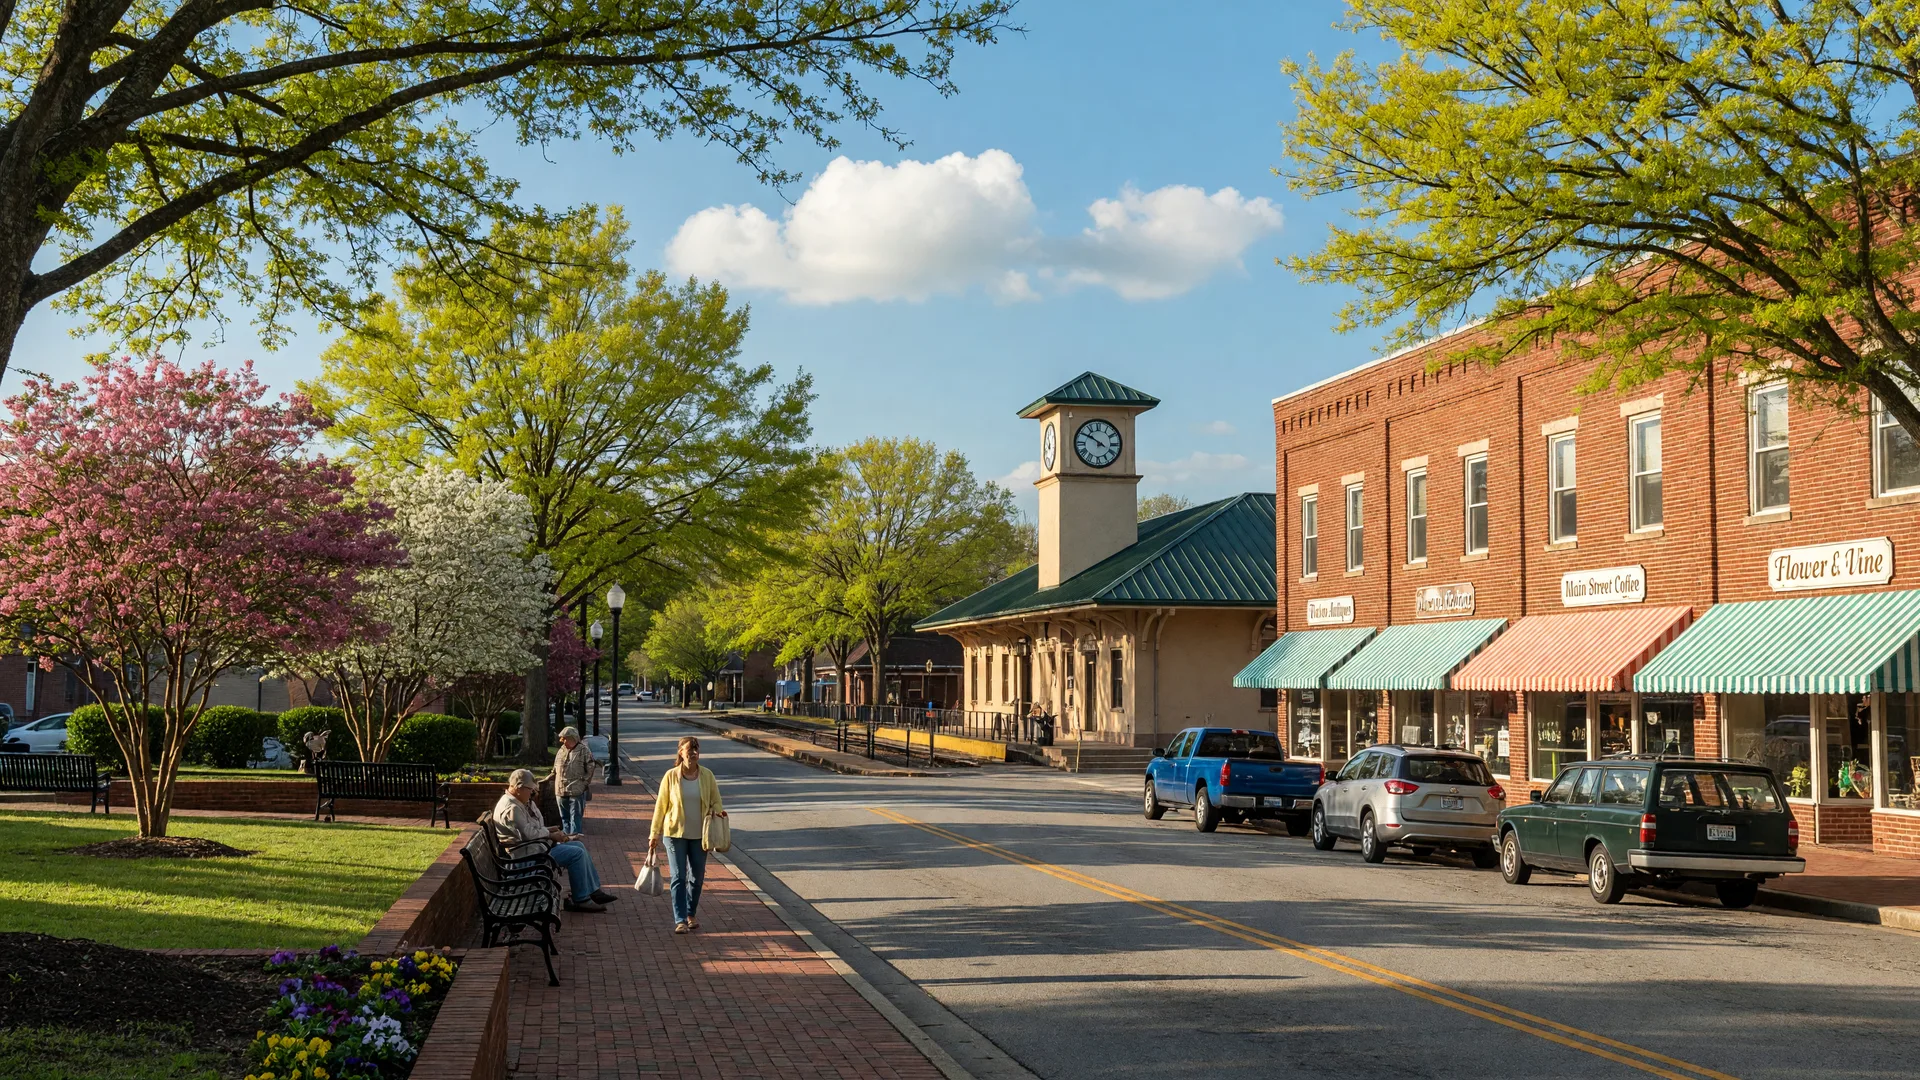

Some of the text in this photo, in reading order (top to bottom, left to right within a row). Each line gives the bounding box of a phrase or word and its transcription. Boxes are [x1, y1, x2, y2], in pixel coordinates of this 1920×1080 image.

[1775, 547, 1883, 581] Flower & Vine
[1565, 574, 1640, 597] Main Street Coffee
